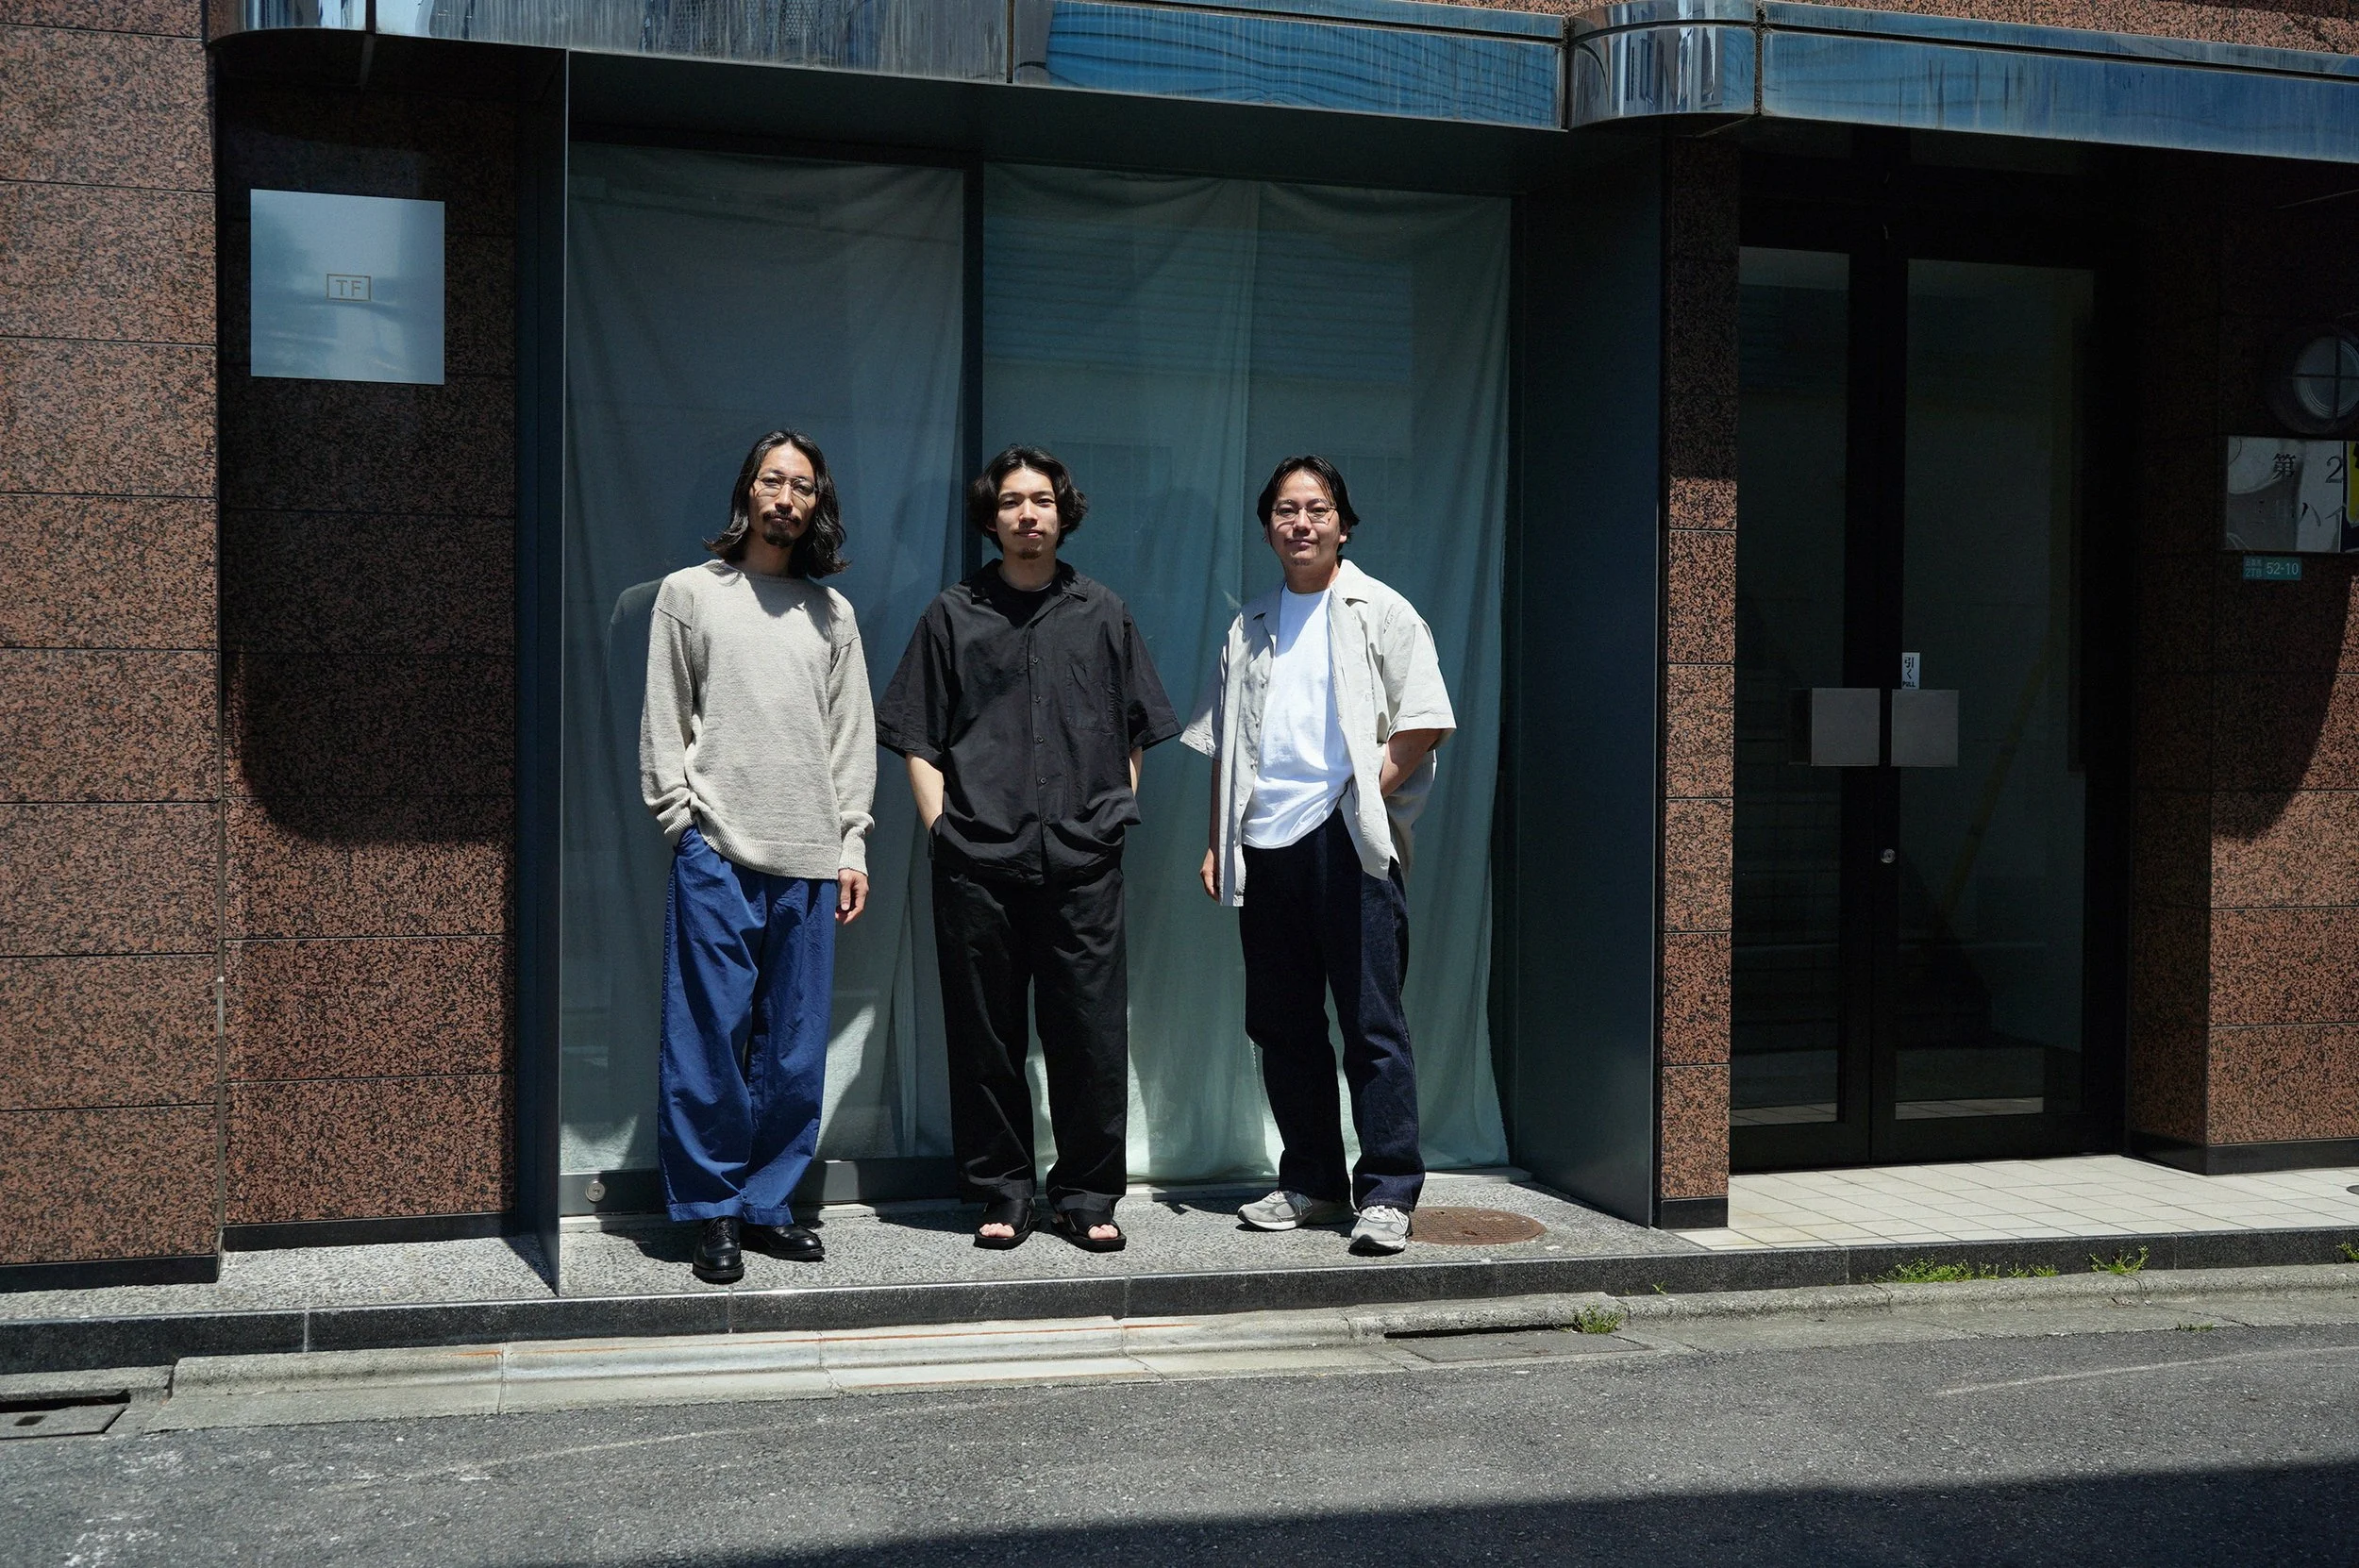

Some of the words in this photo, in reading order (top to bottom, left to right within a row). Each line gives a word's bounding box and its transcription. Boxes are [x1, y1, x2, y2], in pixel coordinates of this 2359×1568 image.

[335, 279, 362, 296] TF
[2272, 453, 2296, 480] 第
[2325, 457, 2344, 483] 2
[2266, 561, 2299, 575] 52-10
[1904, 657, 1915, 679] 引く
